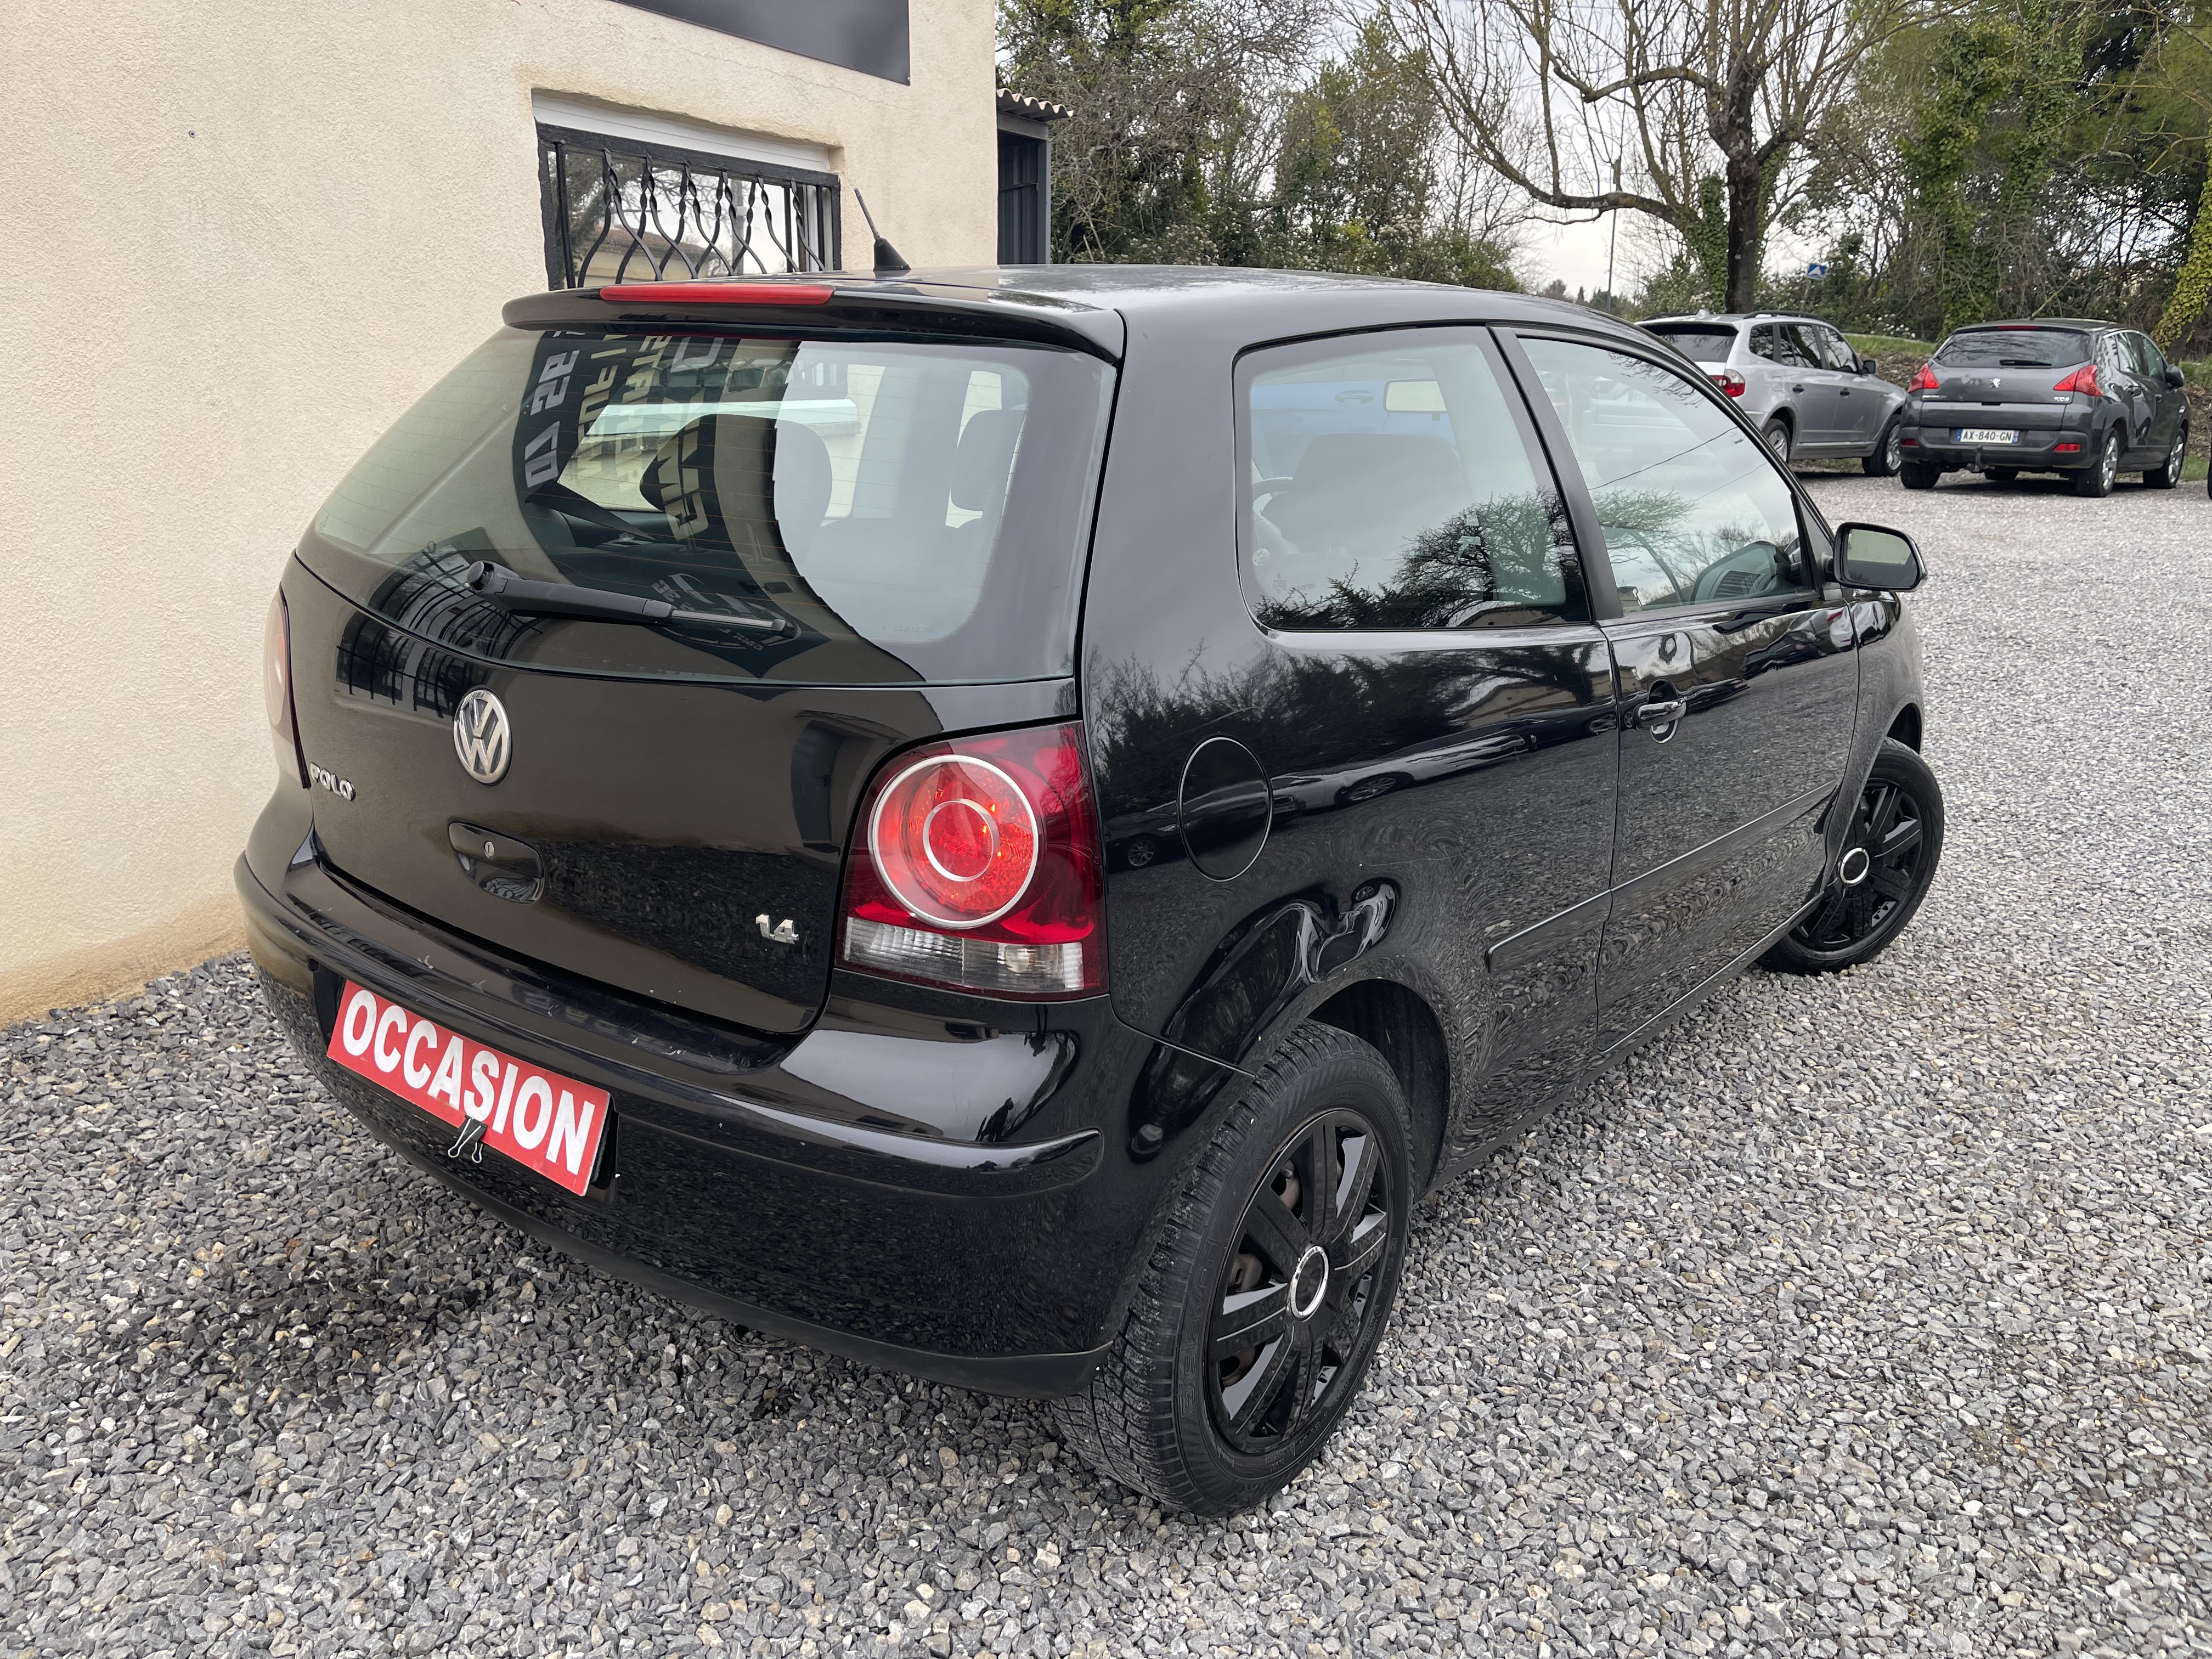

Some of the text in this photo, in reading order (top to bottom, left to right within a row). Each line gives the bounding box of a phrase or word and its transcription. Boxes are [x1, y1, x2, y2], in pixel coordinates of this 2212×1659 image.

[1962, 431, 2012, 441] AX-840-GN
[310, 762, 356, 802] POLO
[342, 989, 596, 1176] OCCASION
